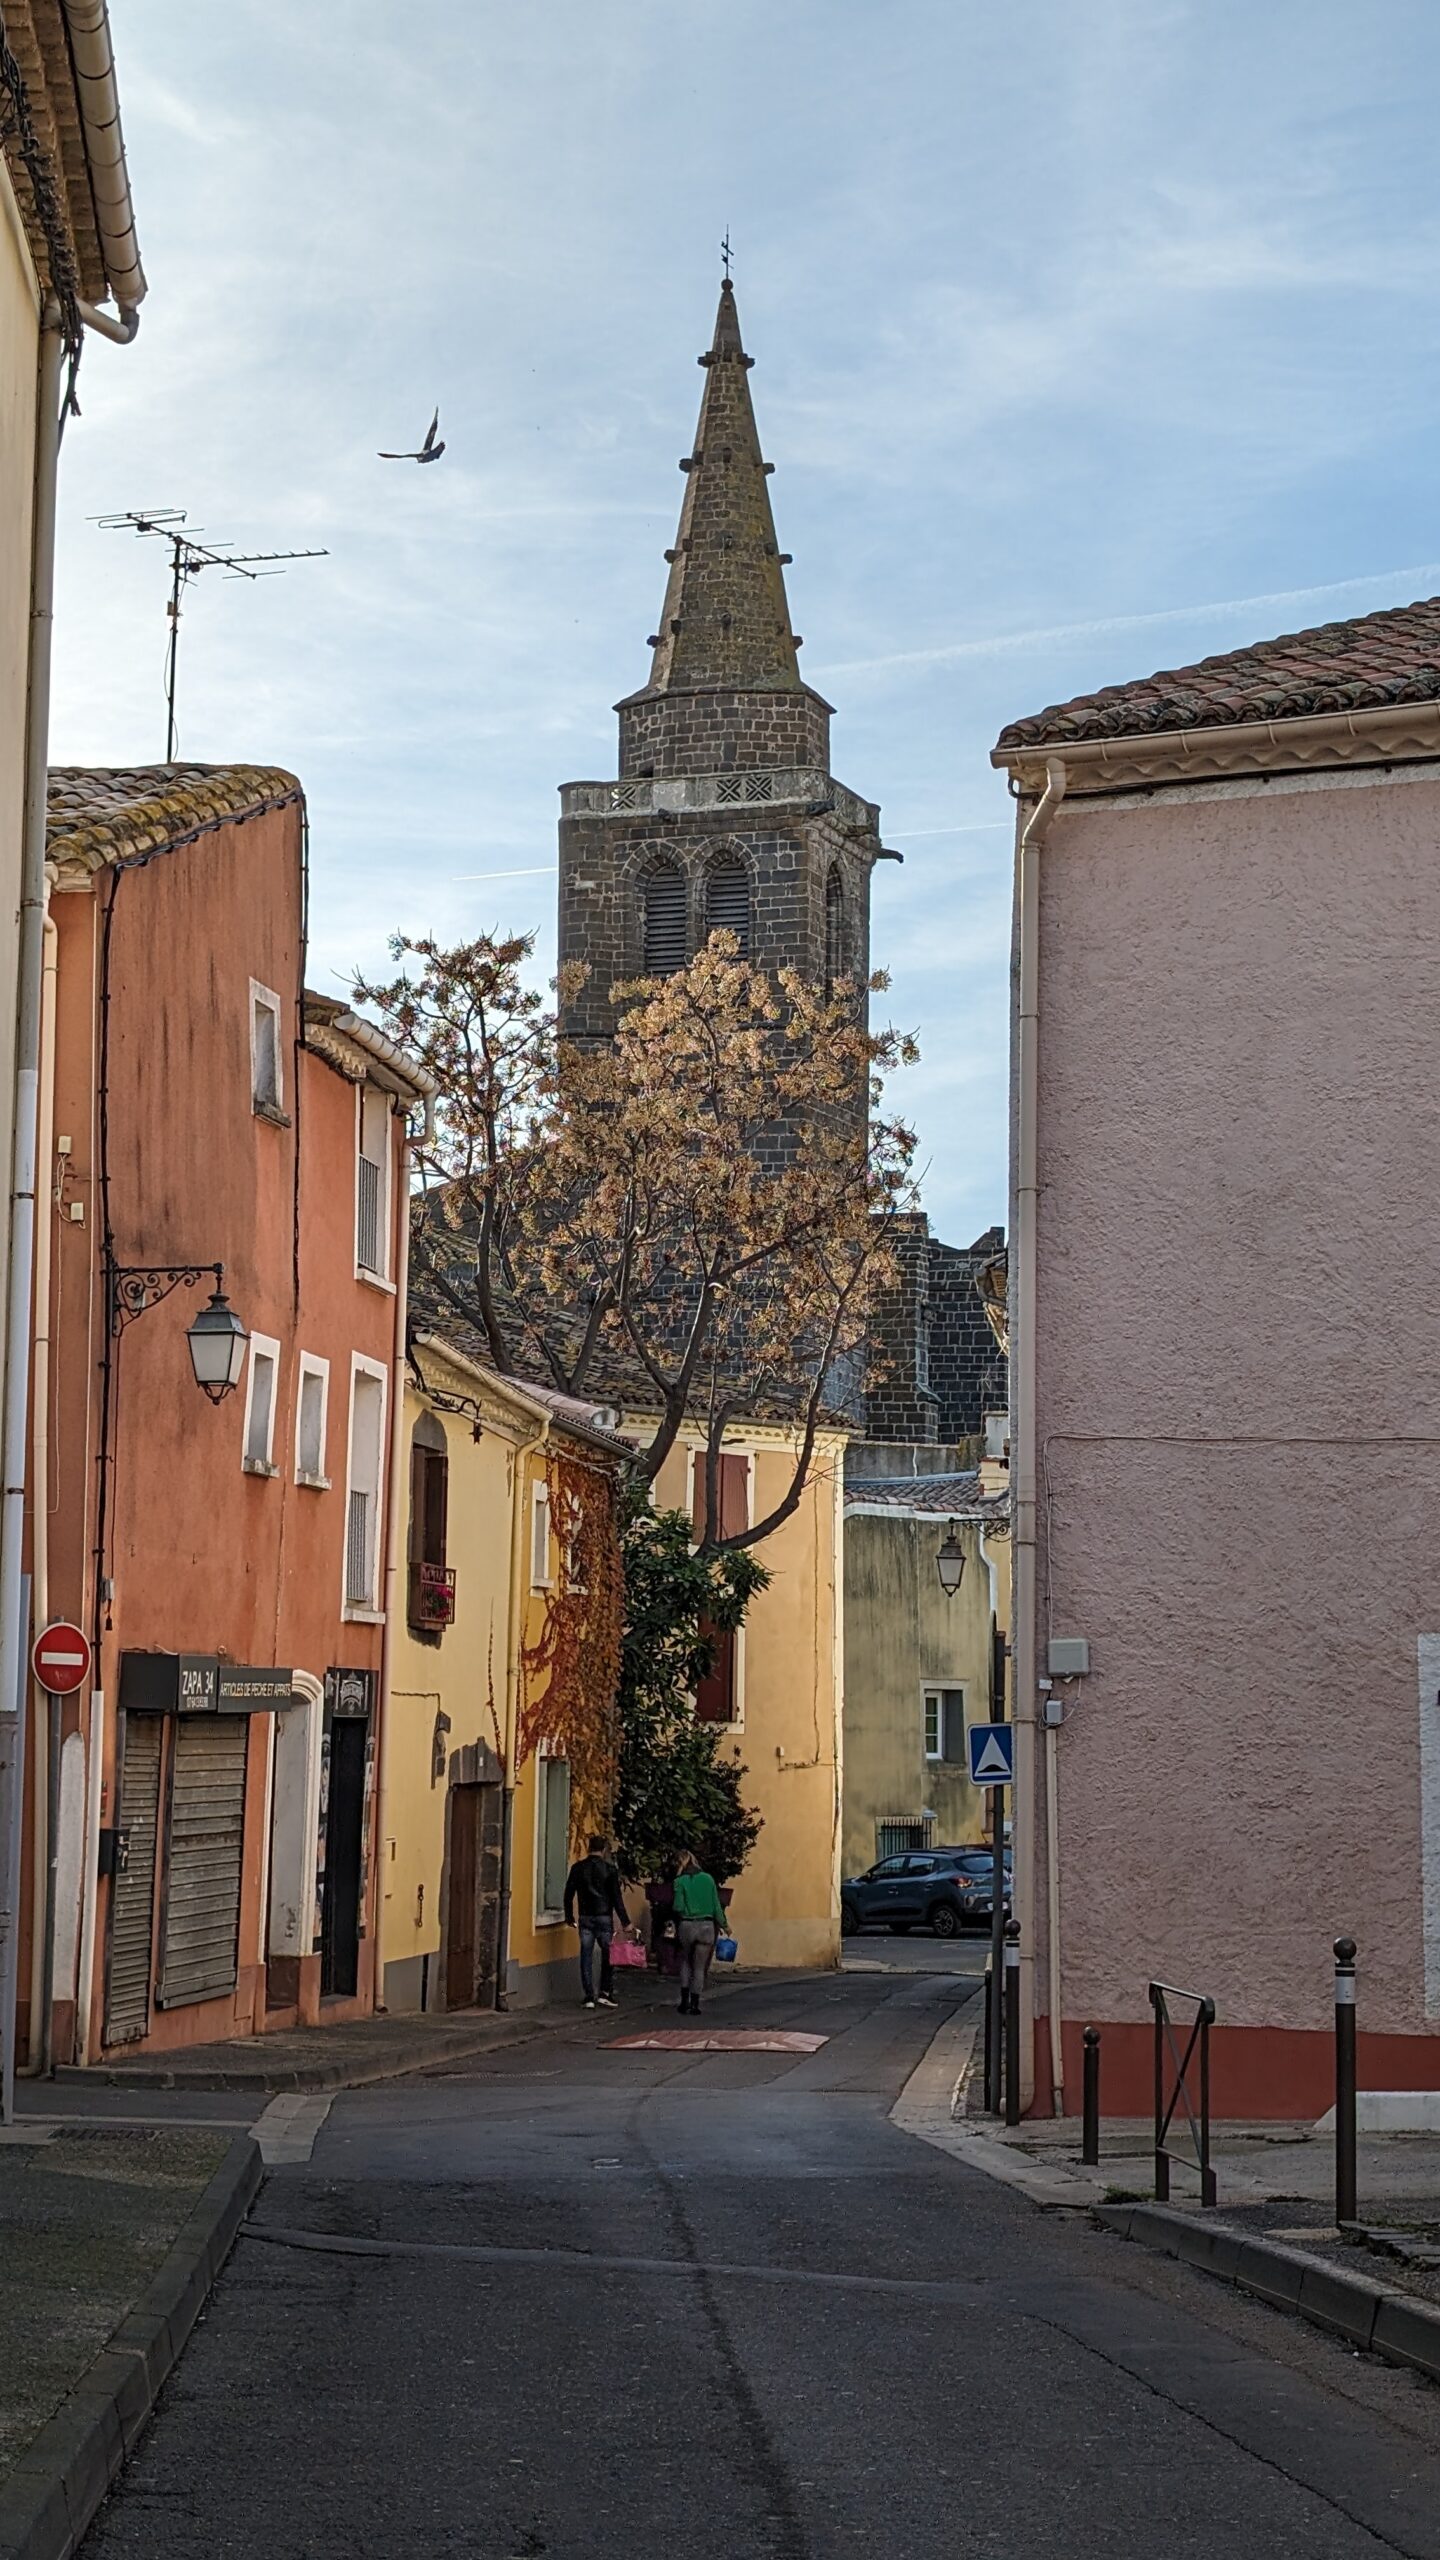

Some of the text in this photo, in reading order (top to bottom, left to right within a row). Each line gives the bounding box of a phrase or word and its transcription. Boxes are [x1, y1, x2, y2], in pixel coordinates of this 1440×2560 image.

[182, 1671, 214, 1695] ZAPA 34
[244, 1683, 251, 1696] DE
[267, 1683, 274, 1696] ET
